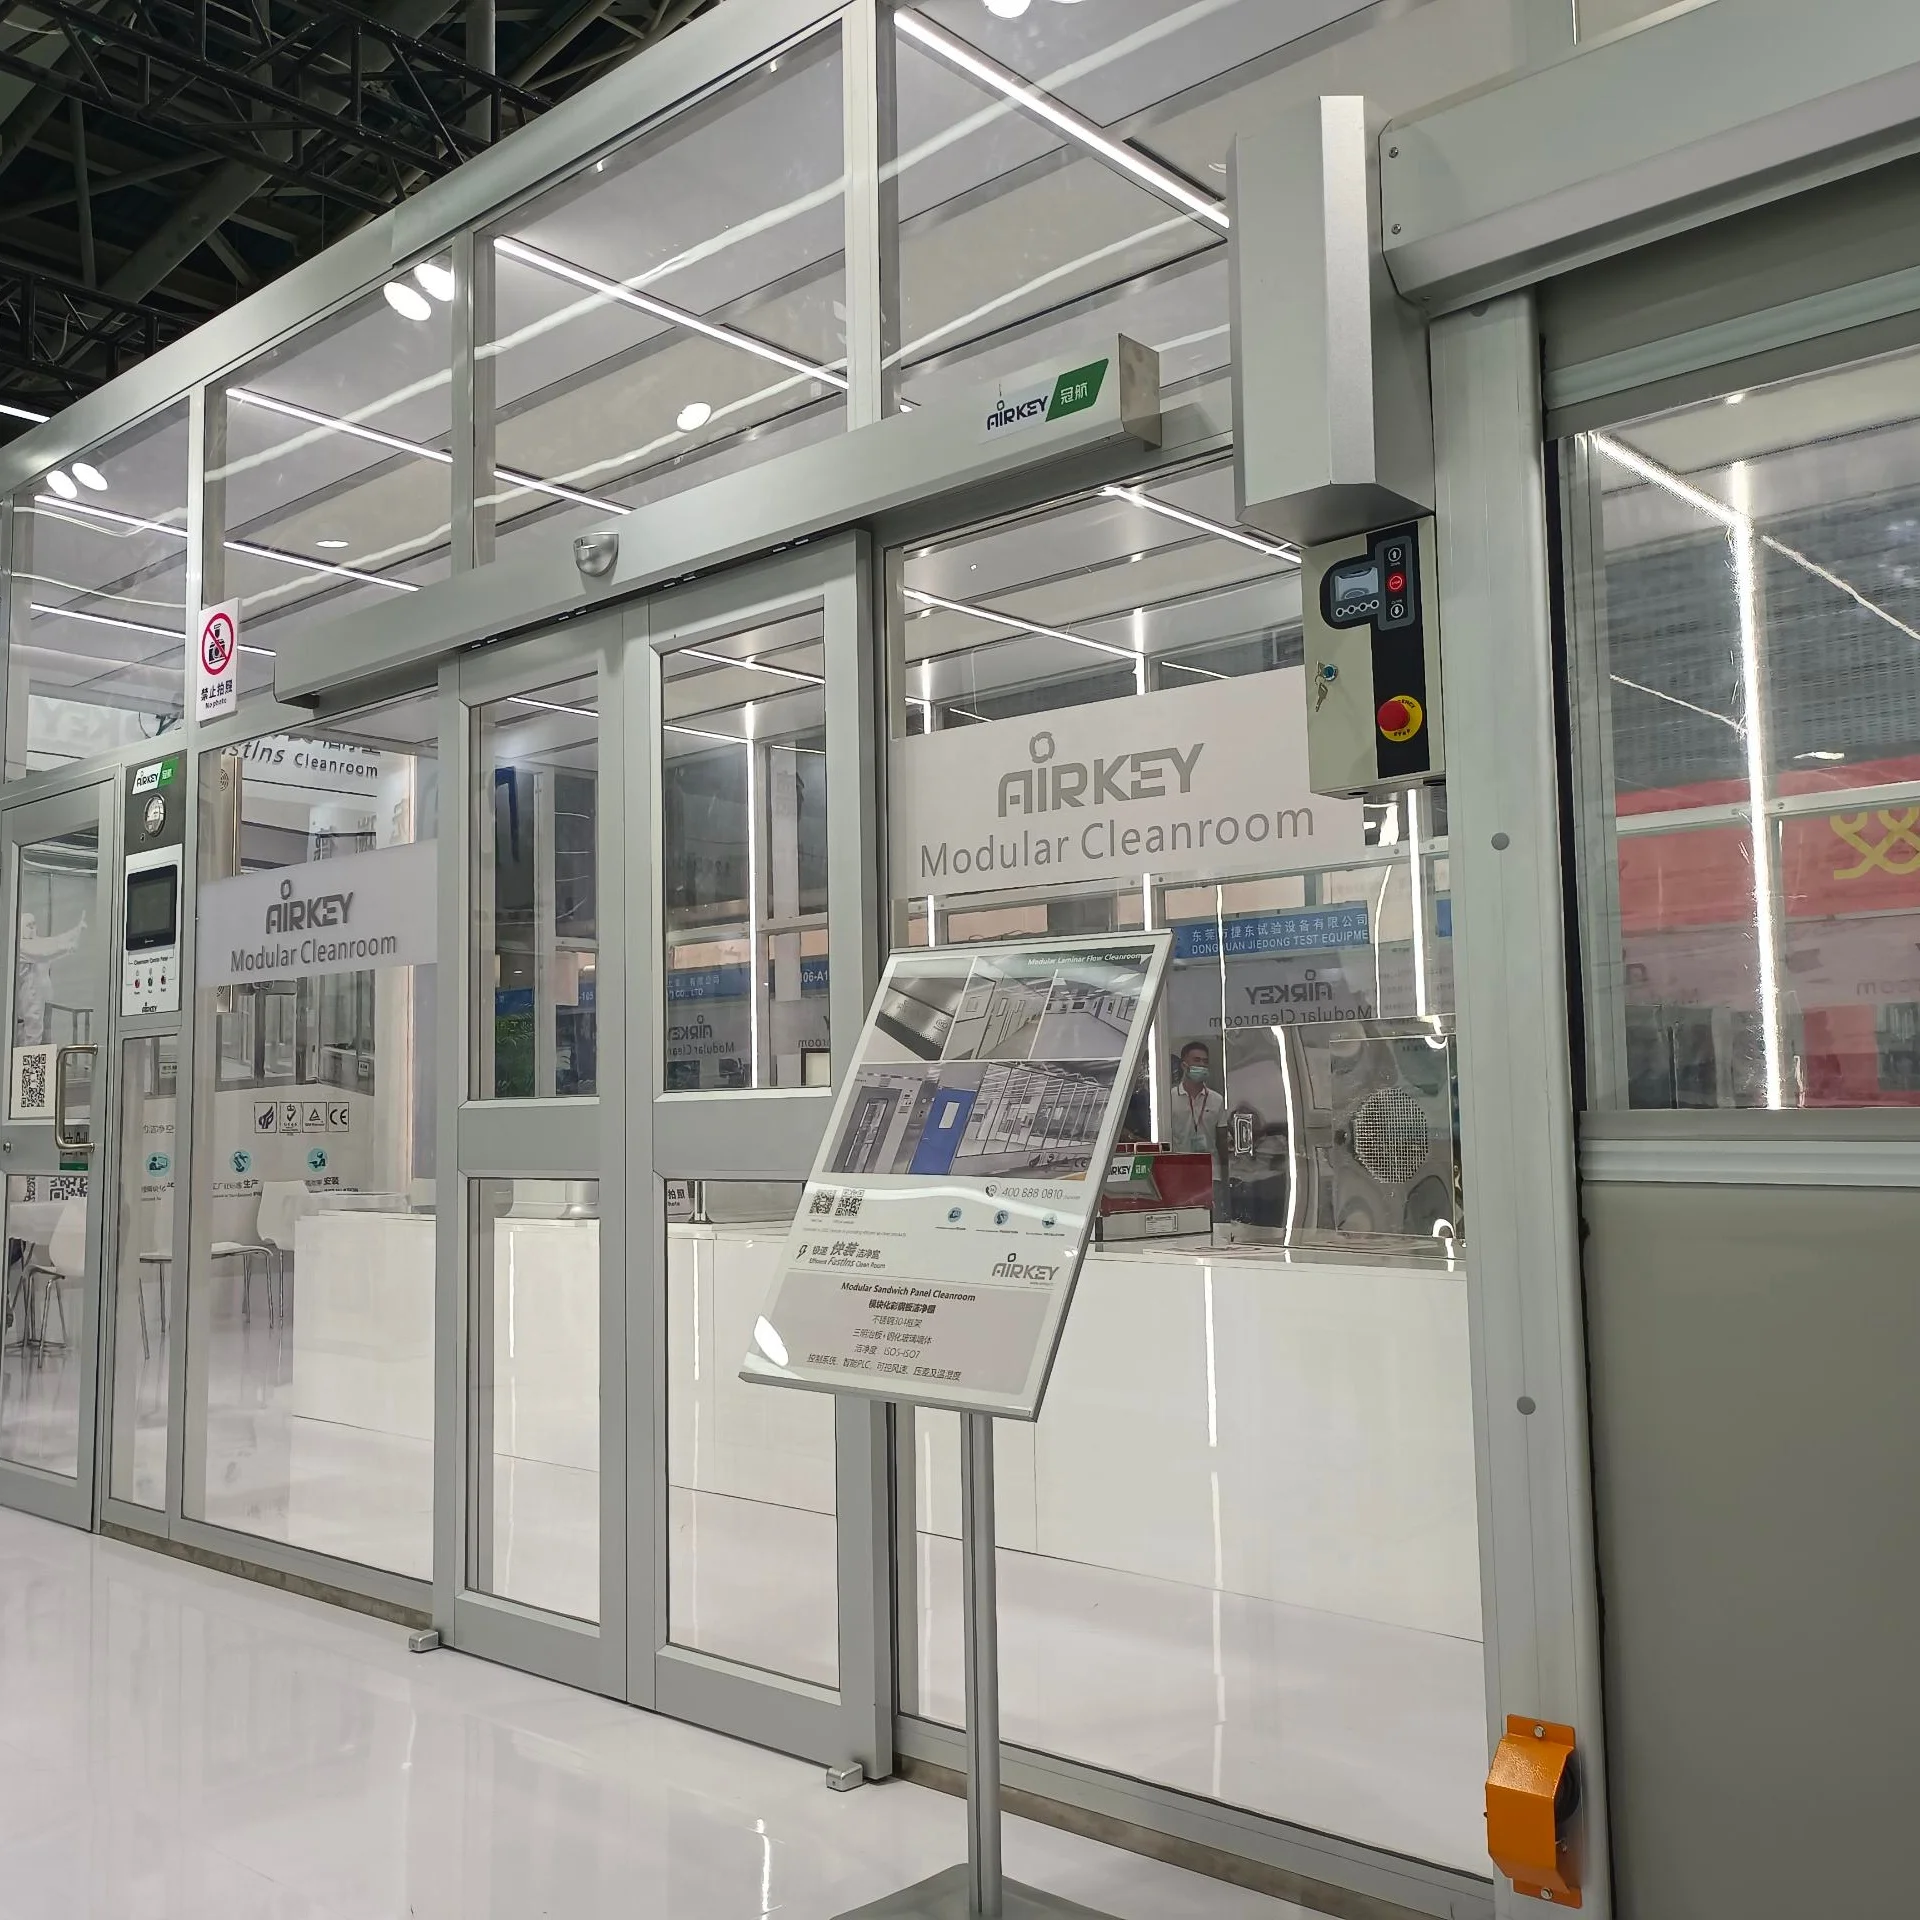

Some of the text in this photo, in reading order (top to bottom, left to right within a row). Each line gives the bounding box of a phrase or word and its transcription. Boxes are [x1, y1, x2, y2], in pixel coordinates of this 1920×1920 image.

[1060, 381, 1088, 405] 冠航
[986, 395, 1048, 430] AIRKEY
[295, 752, 378, 778] Cleanroom
[998, 731, 1205, 818] AIRKEY
[921, 806, 1314, 878] Modular Cleanroom
[265, 879, 353, 935] AIRKEY
[231, 934, 397, 973] Modular Cleanroom
[1192, 941, 1245, 954] DONGUAN
[1248, 936, 1290, 949] JIEDONG
[1293, 934, 1319, 946] TEST
[1086, 954, 1103, 962] Flow
[1002, 1187, 1019, 1198] 400
[1021, 1187, 1038, 1199] 888
[1041, 1188, 1063, 1200] 0810
[991, 1252, 1060, 1280] AIRKEY
[841, 1282, 976, 1302] Modular Sandwich Panel Cleanroom
